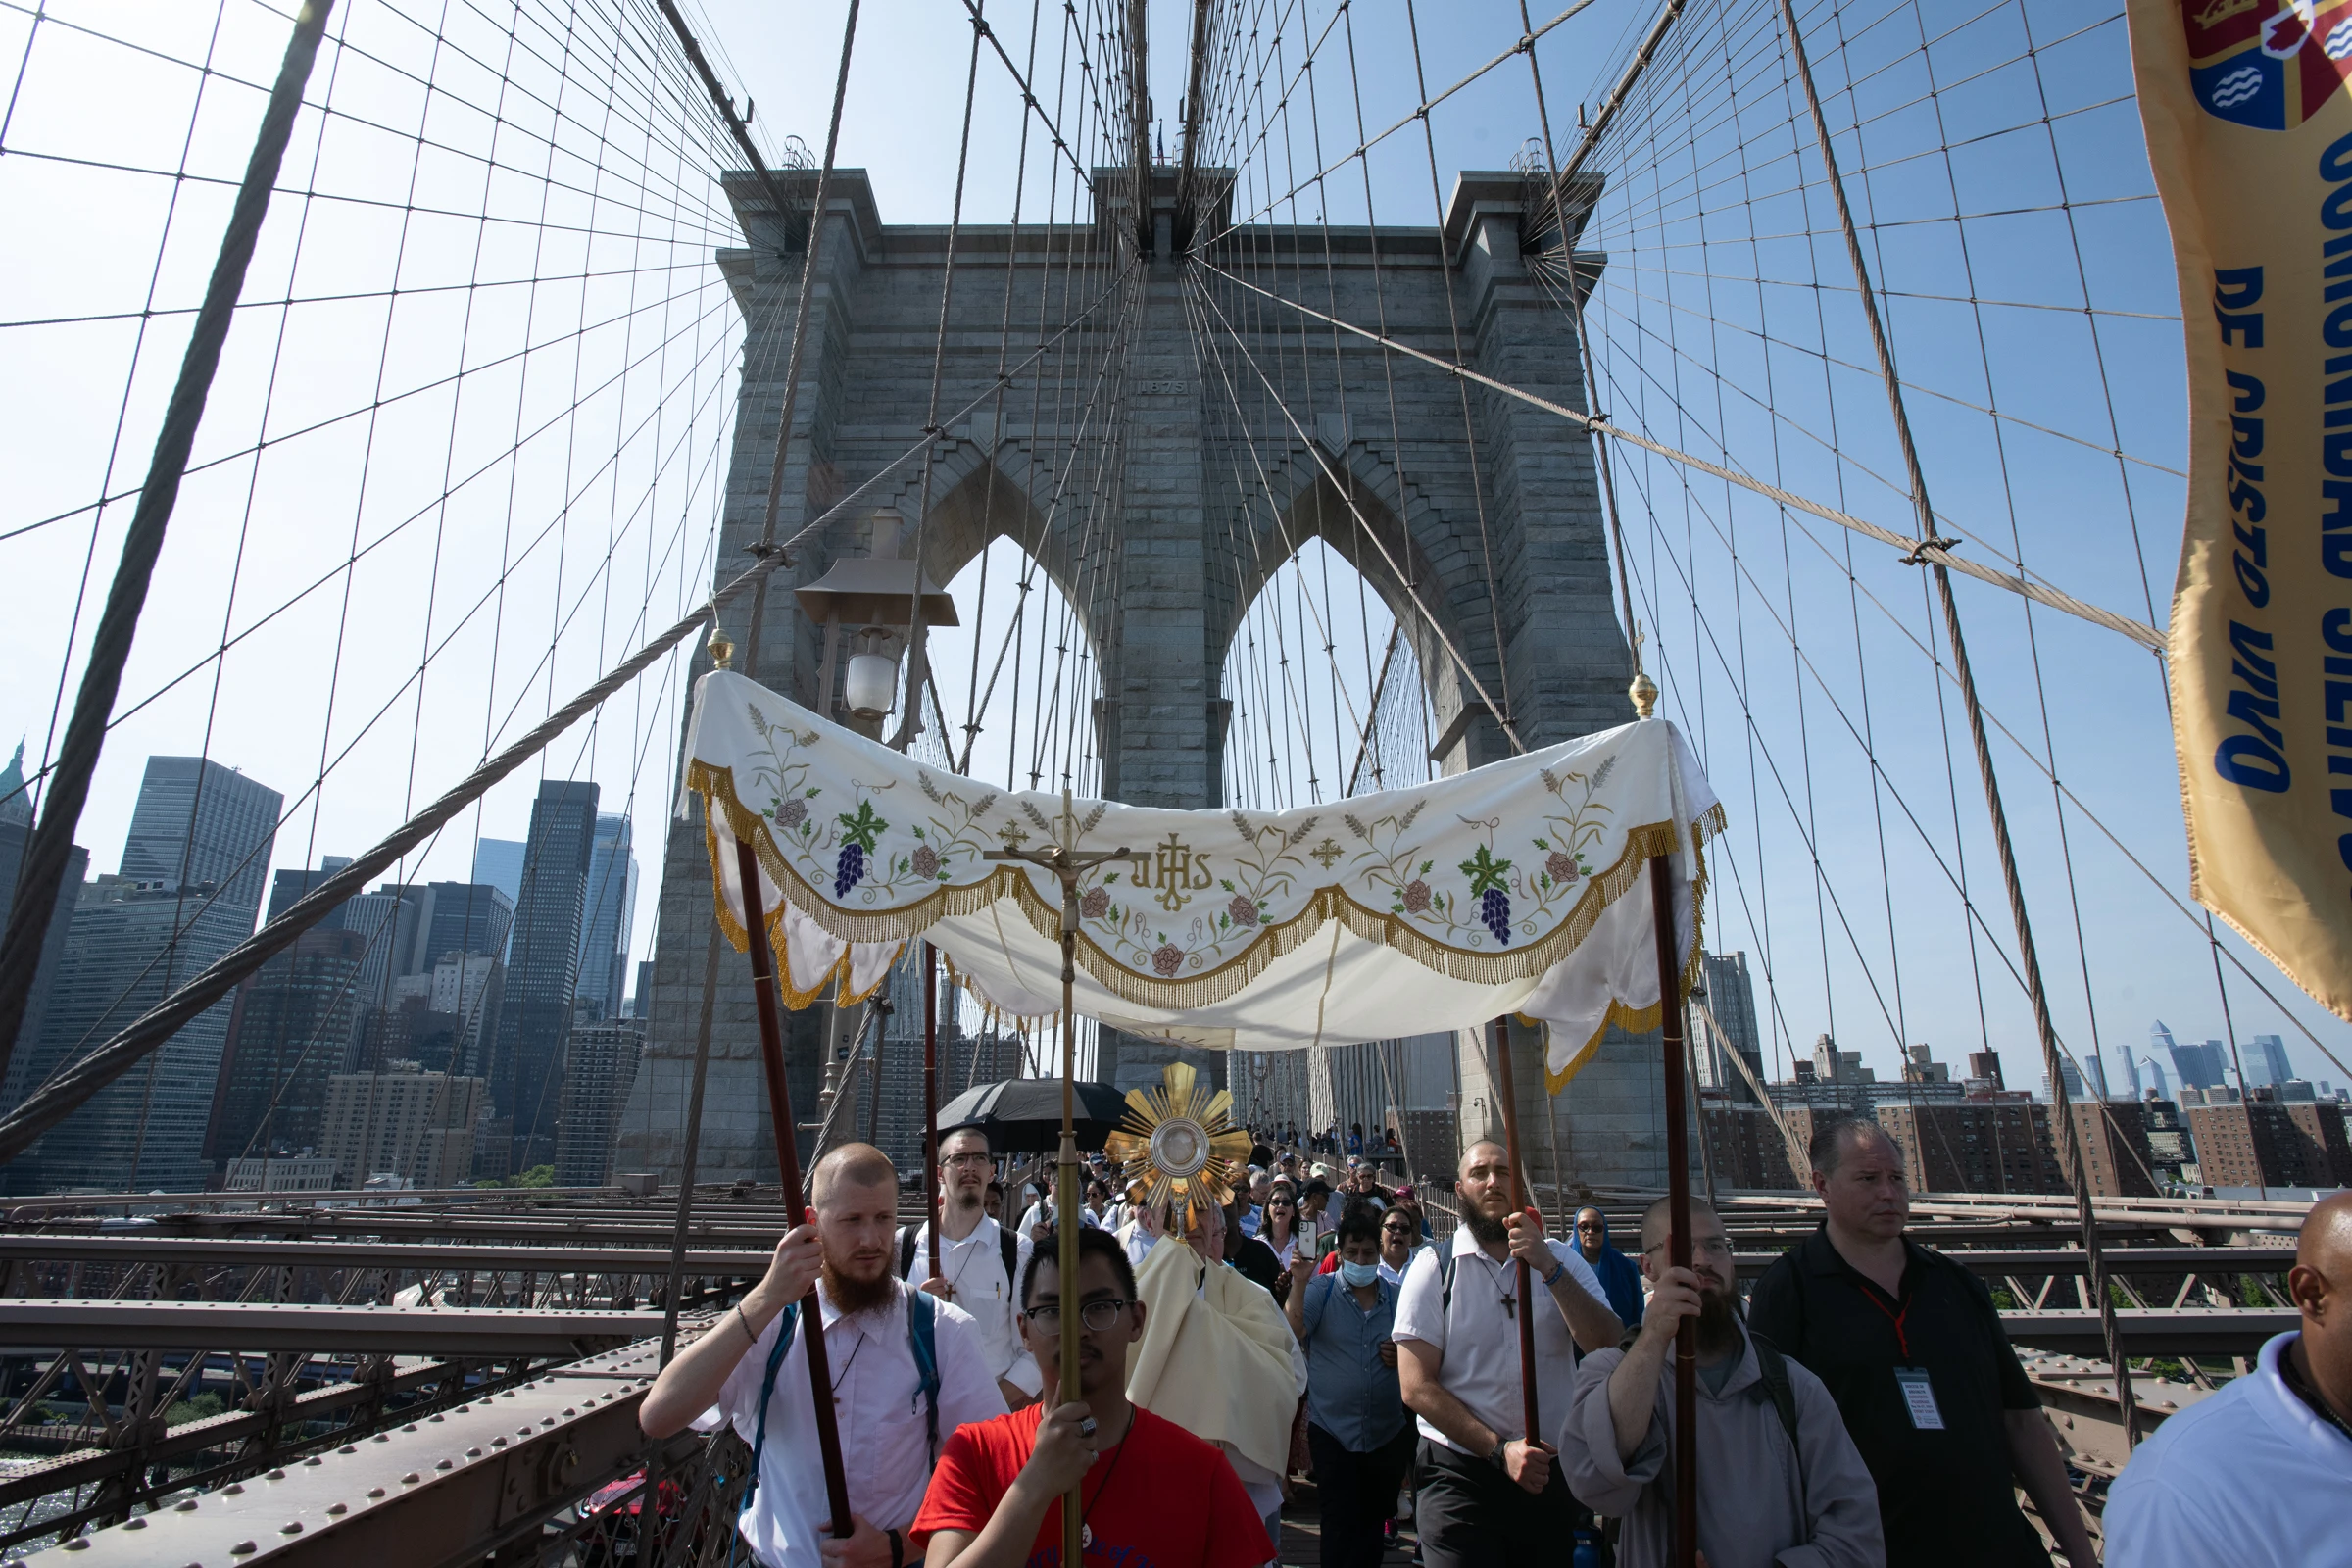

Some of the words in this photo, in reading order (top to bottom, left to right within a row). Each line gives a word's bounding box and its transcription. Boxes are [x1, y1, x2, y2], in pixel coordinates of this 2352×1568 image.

[2214, 266, 2264, 349] DE
[1141, 381, 1184, 394] 1875
[2214, 619, 2291, 794] VIVO
